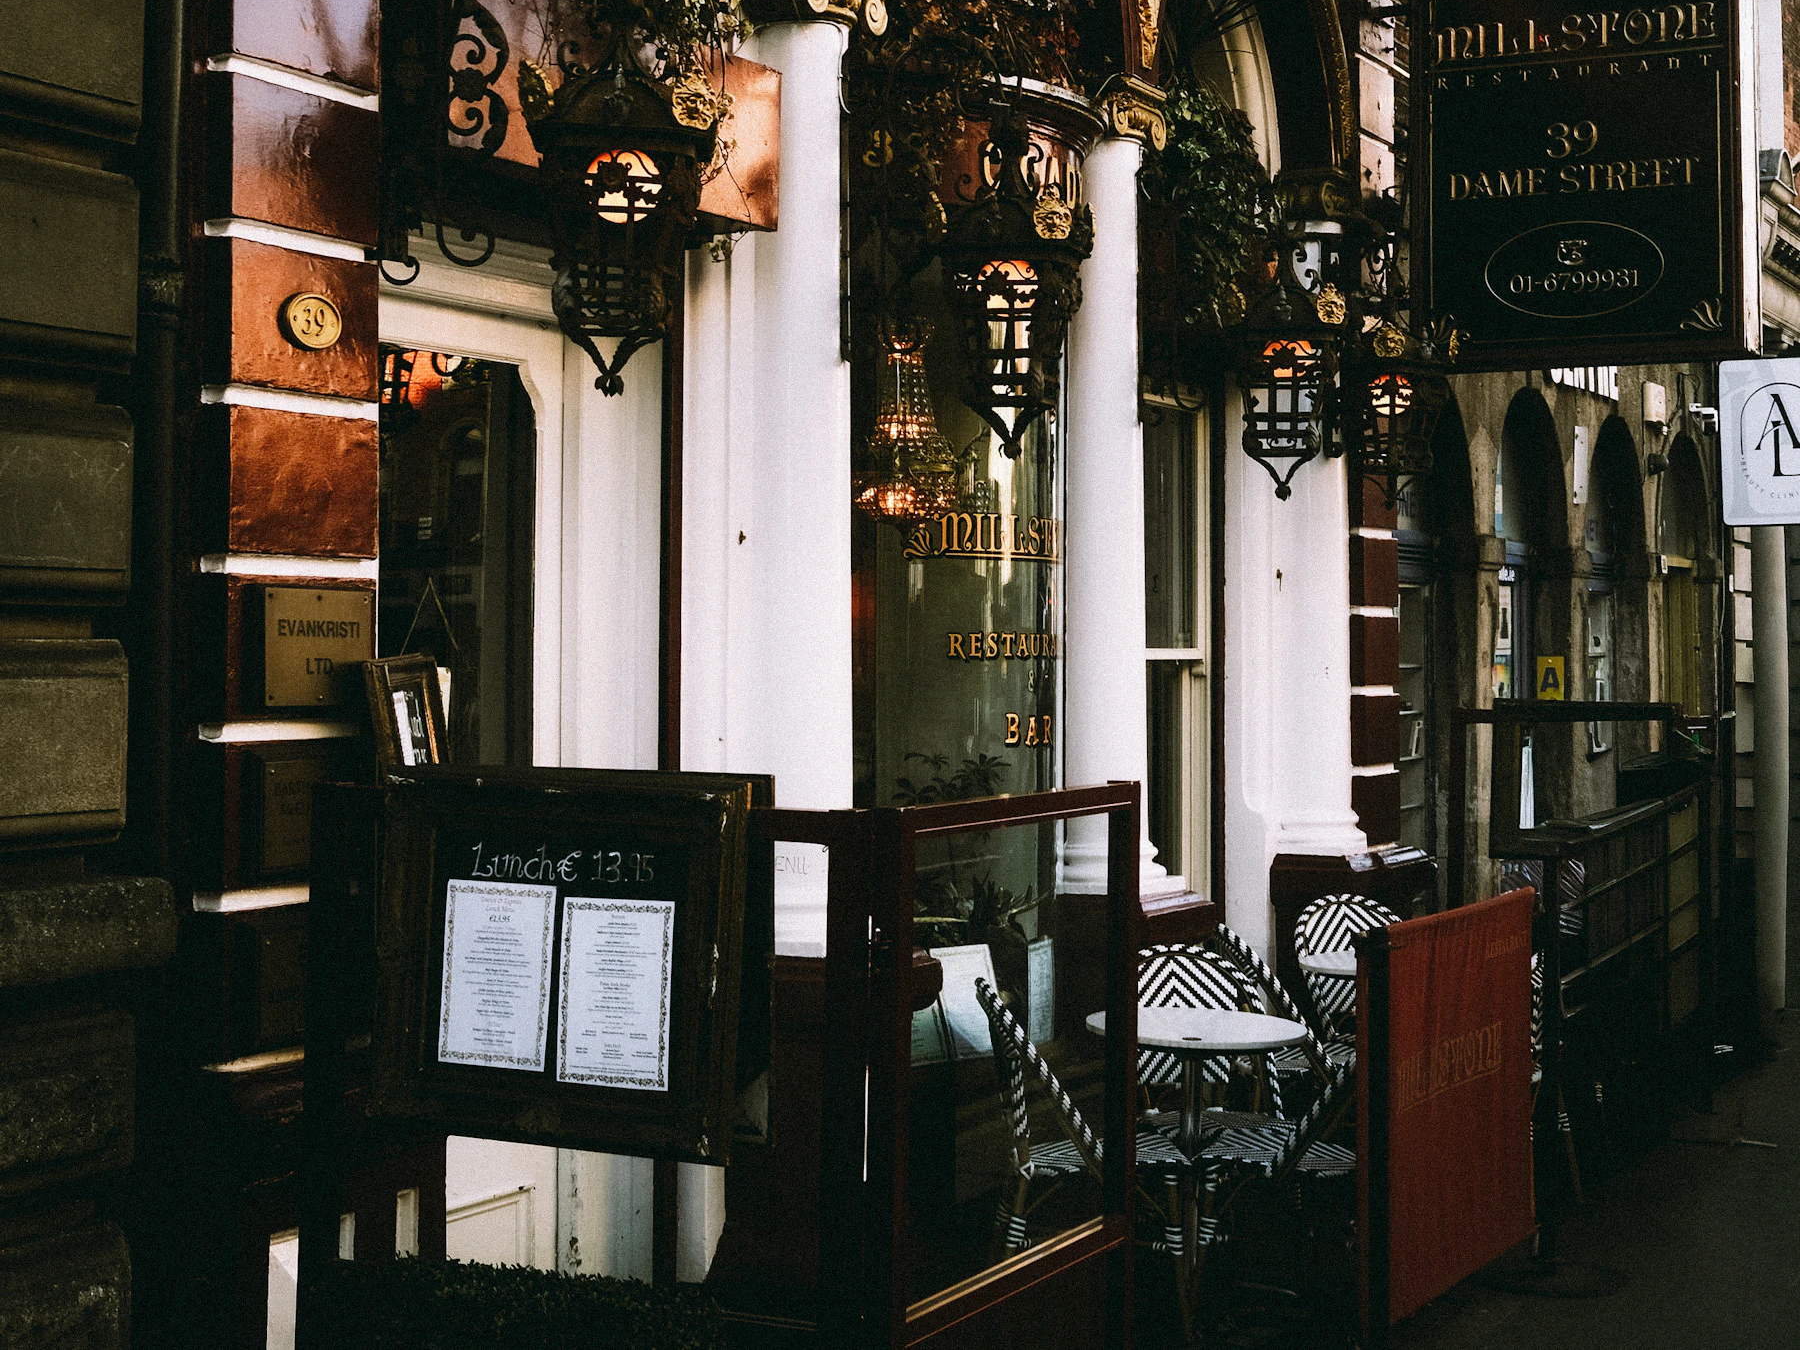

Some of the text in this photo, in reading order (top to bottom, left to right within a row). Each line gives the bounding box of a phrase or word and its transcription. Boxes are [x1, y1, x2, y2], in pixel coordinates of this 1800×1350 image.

[1434, 1, 1716, 64] MILLSTONE
[1437, 54, 1712, 90] RESTAURANT
[1546, 120, 1599, 159] 39
[1448, 157, 1701, 201] DAME STREET
[1509, 268, 1640, 295] 01-6799931
[301, 307, 326, 337] 39
[278, 619, 360, 638] EVANKRISTI
[306, 657, 333, 675] LTD
[1028, 669, 1035, 692] &
[1540, 667, 1560, 693] A
[1005, 712, 1053, 747] BAR
[472, 842, 555, 880] Lunch
